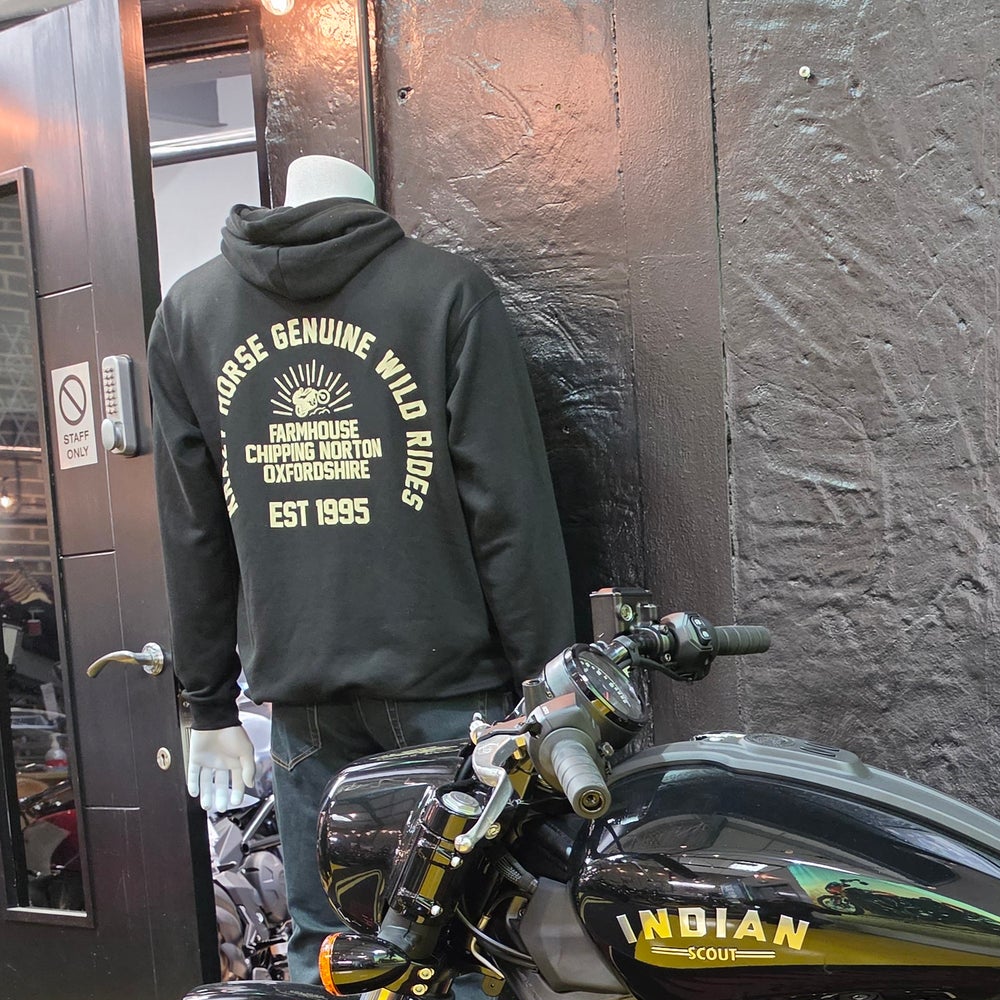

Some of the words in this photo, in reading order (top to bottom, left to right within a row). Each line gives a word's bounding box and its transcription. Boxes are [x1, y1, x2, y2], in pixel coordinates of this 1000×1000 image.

[270, 317, 377, 360] GENUINE
[374, 349, 428, 421] WILD
[401, 430, 434, 512] RIDES
[63, 430, 90, 445] STAFF
[269, 419, 360, 443] FARMHOUSE
[66, 446, 89, 460] ONLY
[244, 442, 316, 464] CHIPPING
[318, 437, 383, 461] NORTON
[263, 459, 371, 484] OXFORDSHIRE
[268, 500, 309, 528] EST
[315, 497, 371, 526] 1995
[615, 907, 811, 950] INDIAN
[688, 946, 738, 962] SCOUT
